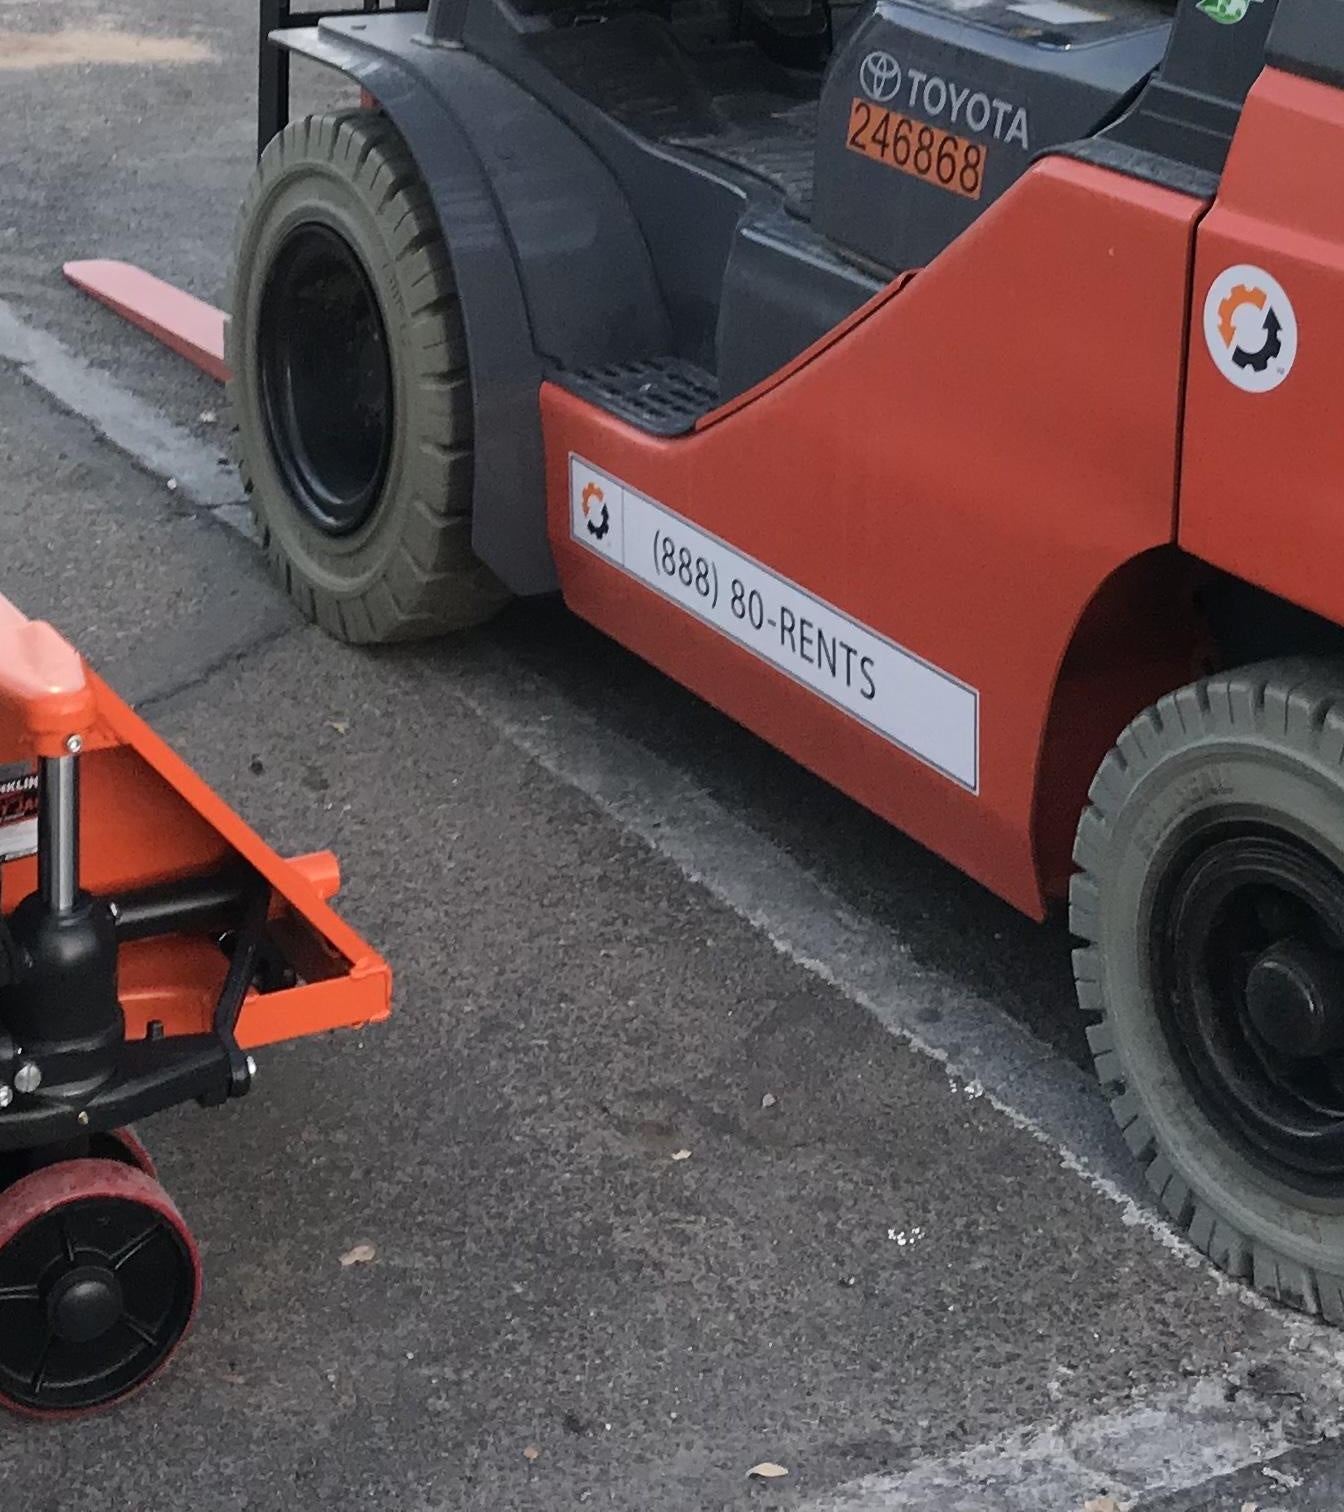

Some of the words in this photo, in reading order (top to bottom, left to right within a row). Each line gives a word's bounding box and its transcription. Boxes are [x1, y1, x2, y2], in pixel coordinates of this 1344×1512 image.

[850, 102, 982, 193] 246868
[907, 68, 1029, 151] TOYOTA
[653, 528, 718, 609] (888)
[730, 578, 876, 700] 80-RENTS
